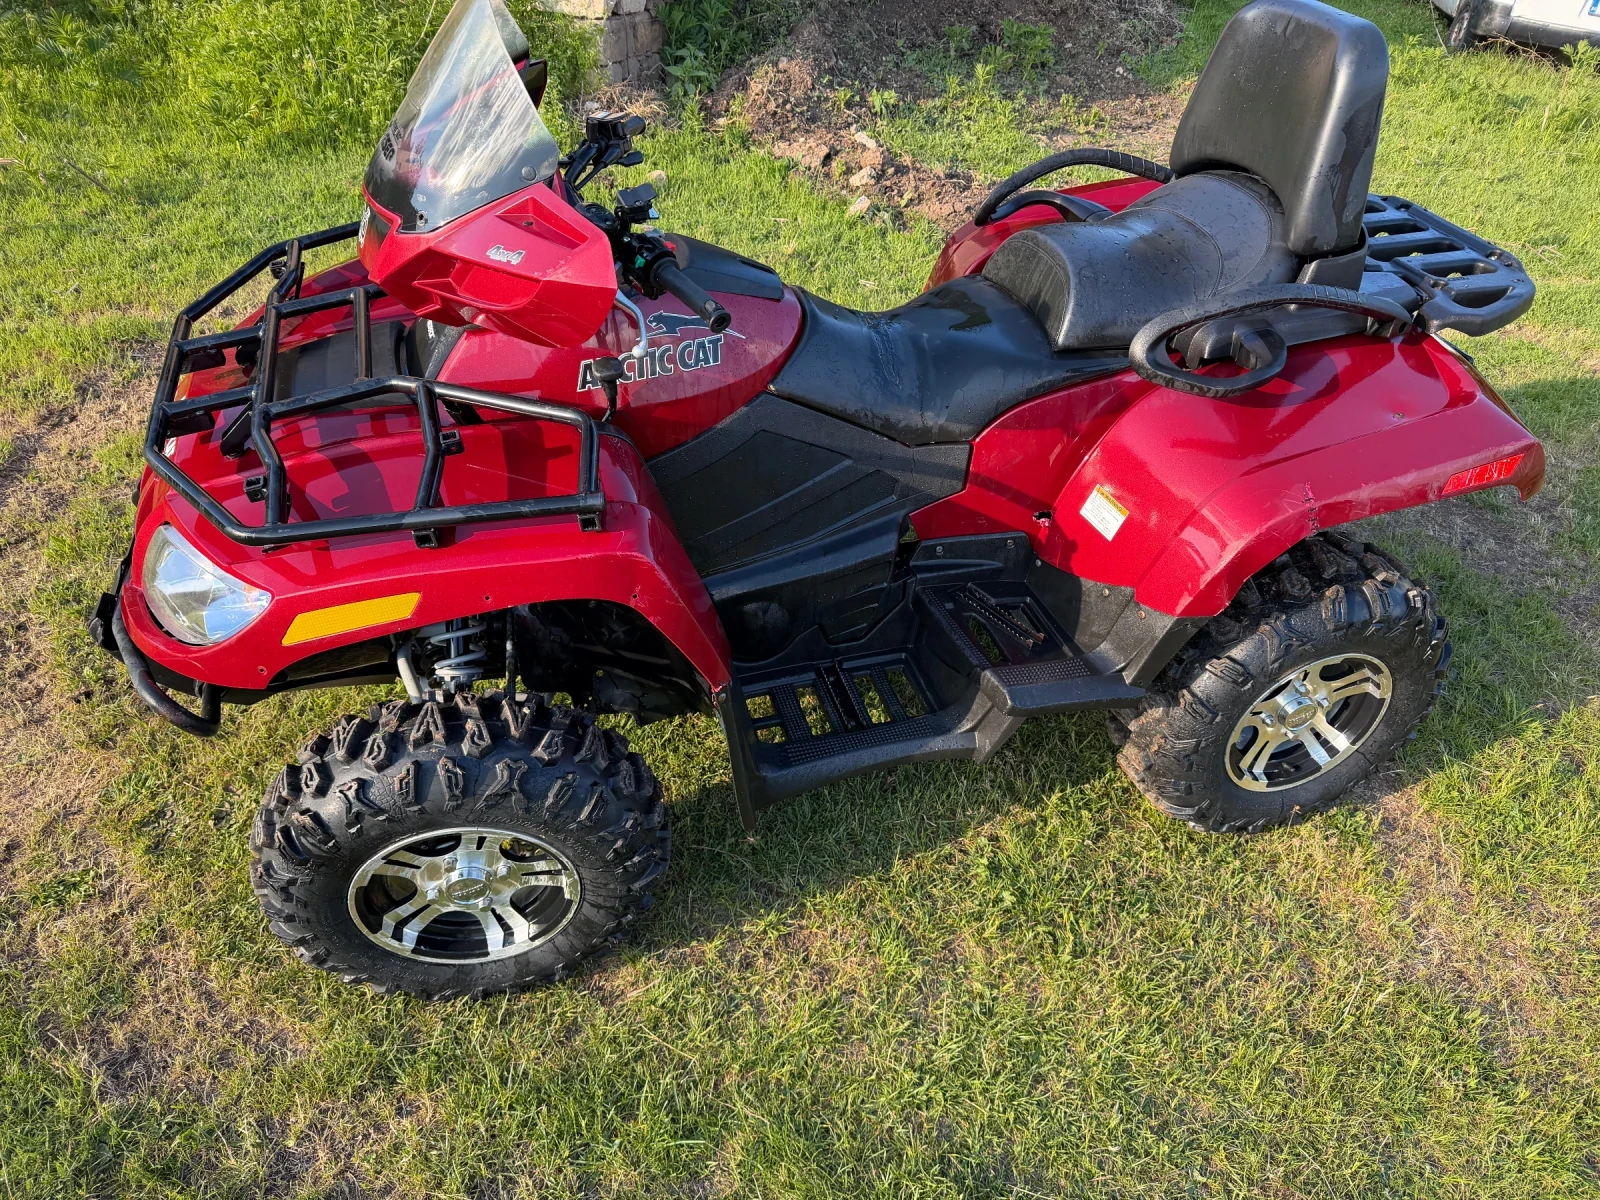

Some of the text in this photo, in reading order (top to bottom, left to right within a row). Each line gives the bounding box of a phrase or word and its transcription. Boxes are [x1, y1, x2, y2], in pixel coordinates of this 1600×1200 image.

[486, 244, 525, 265] 4x4
[577, 334, 723, 392] ACTIC CAT
